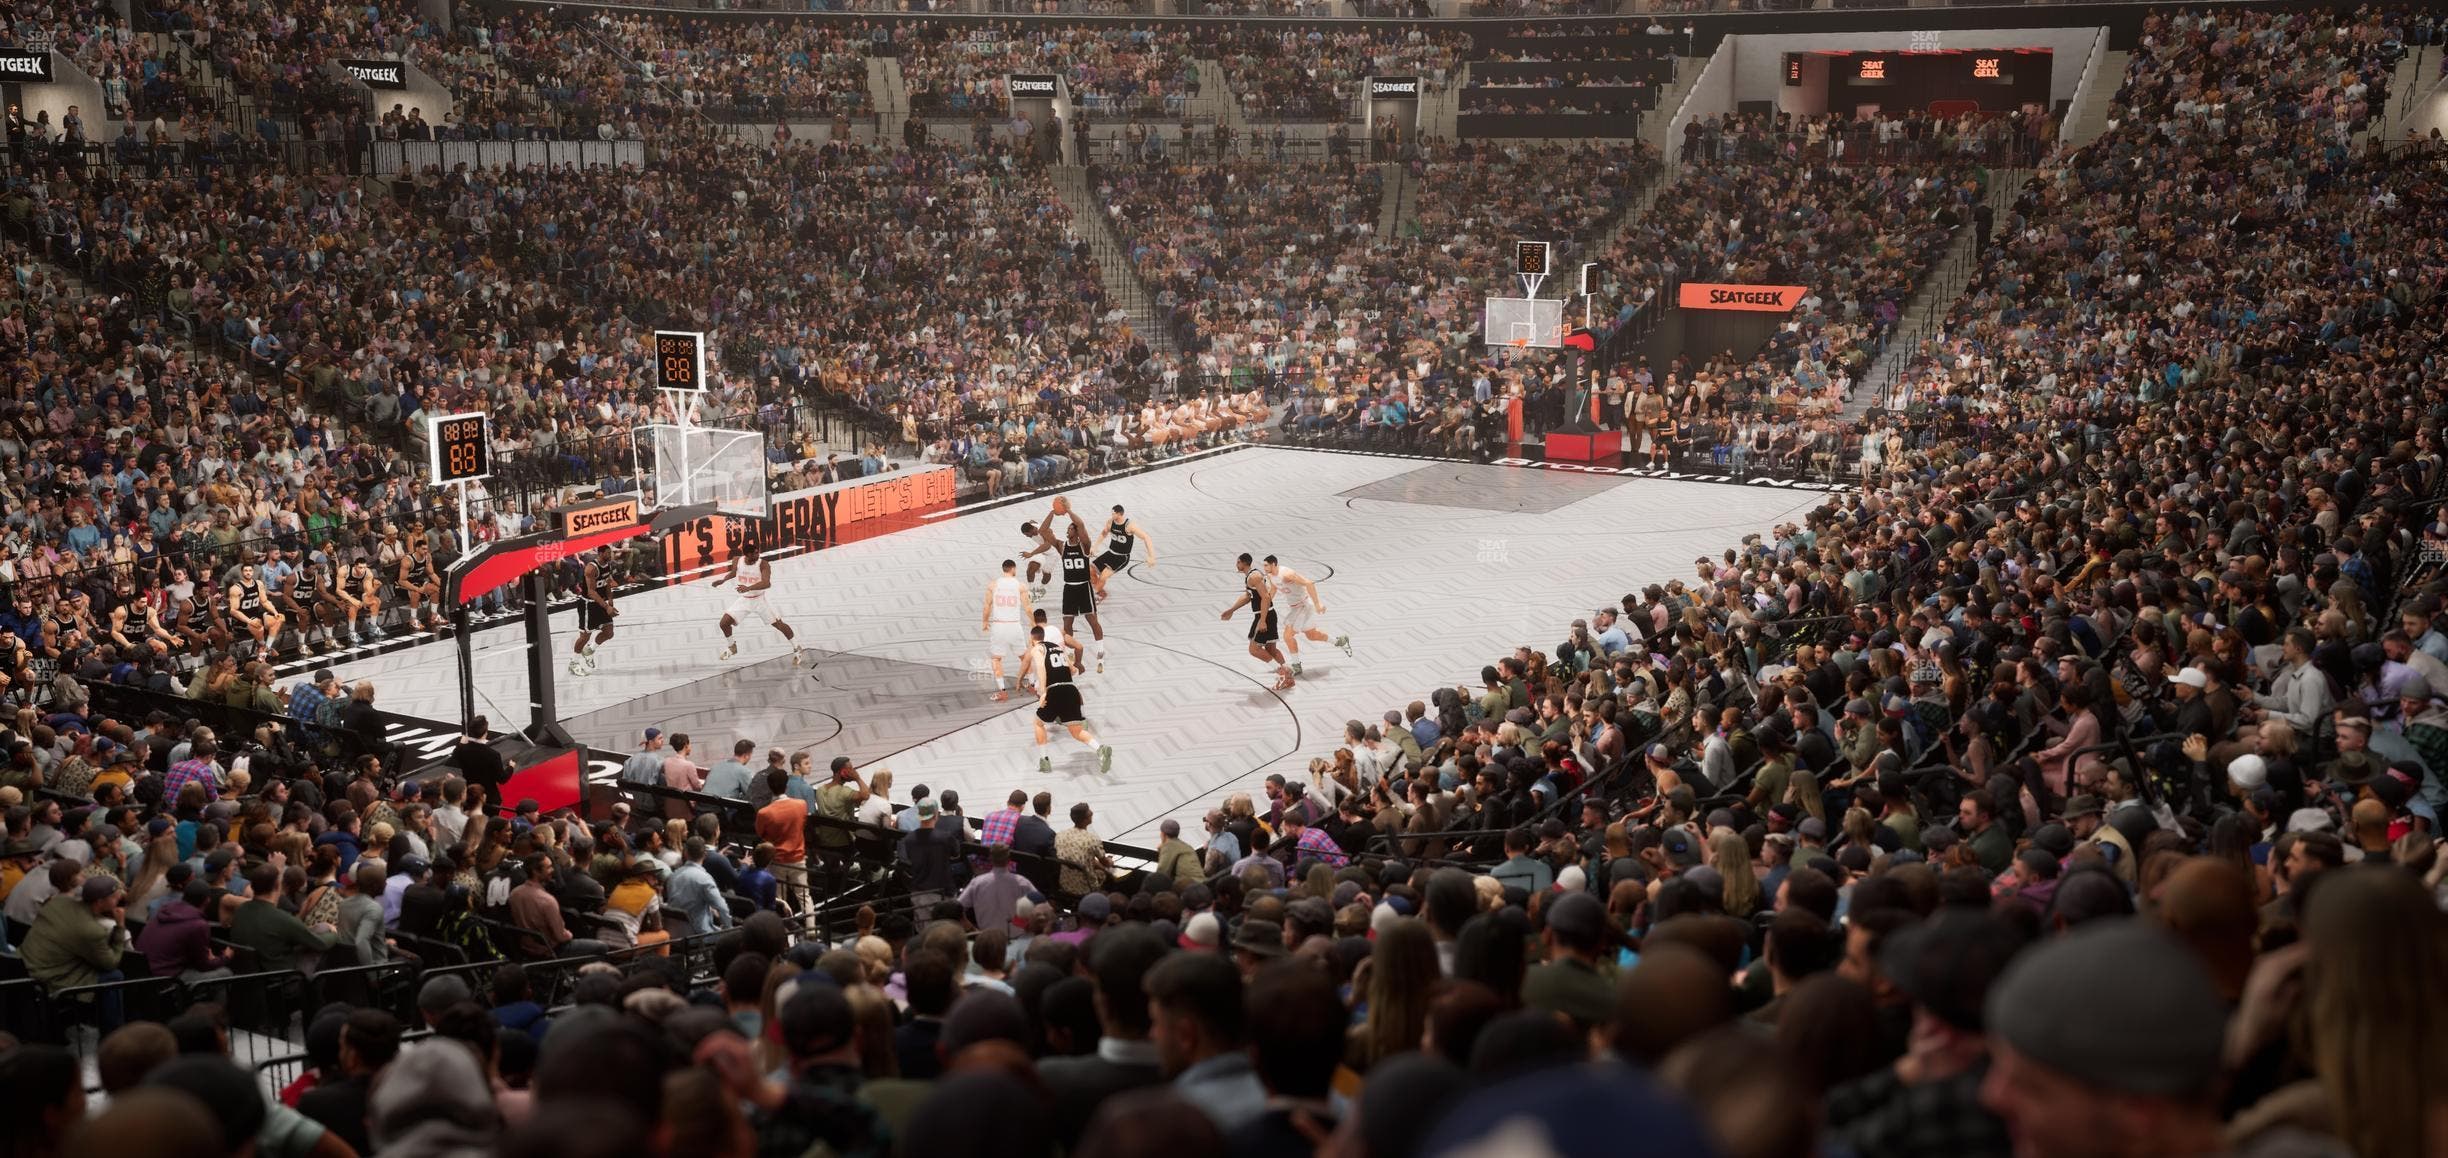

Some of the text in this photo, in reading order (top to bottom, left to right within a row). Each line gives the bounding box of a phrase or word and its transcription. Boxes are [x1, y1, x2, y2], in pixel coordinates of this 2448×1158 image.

[1862, 61, 1885, 69] SEAT
[1975, 59, 1999, 68] SEAT
[1011, 80, 1054, 92] SEATGEEK
[1372, 82, 1416, 93] SEATGEEK
[1710, 289, 1783, 306] SEATGEEK
[849, 476, 912, 523] LET'S
[573, 504, 631, 532] SEATGEEK
